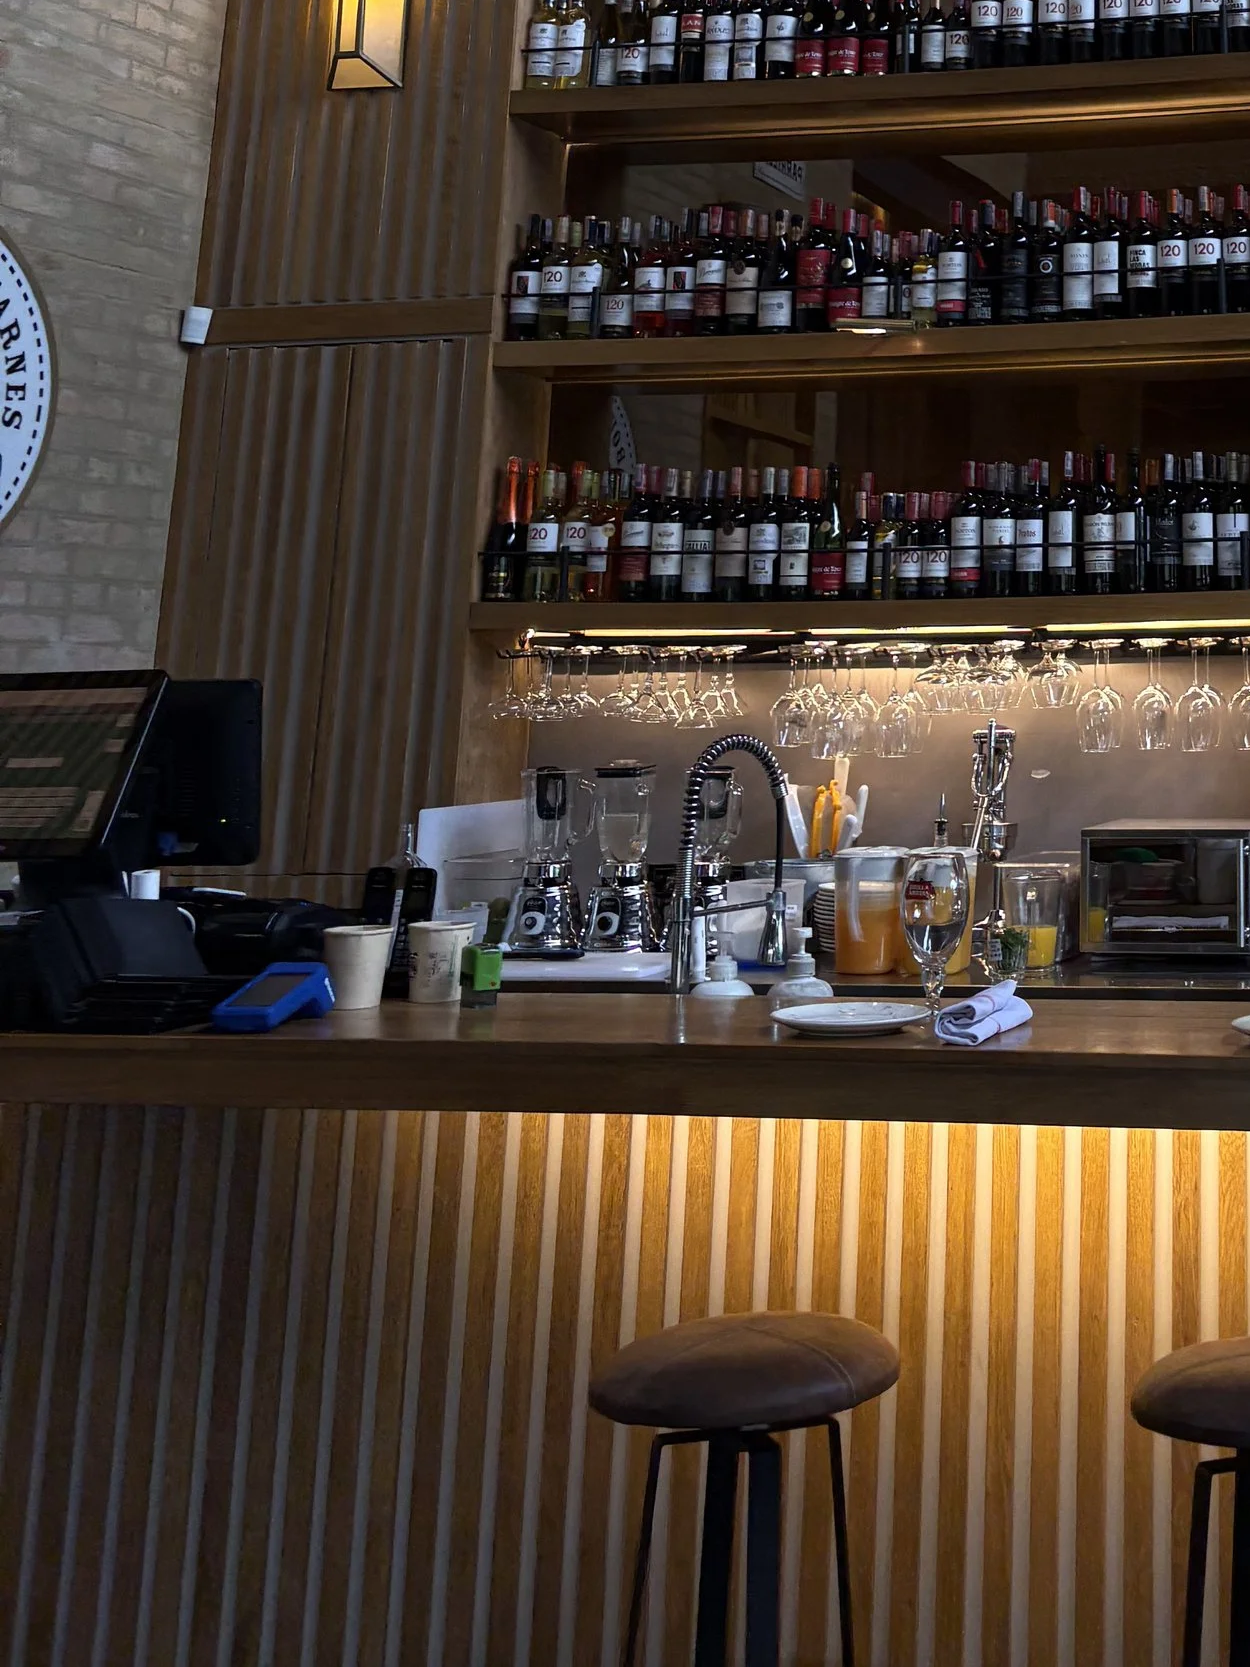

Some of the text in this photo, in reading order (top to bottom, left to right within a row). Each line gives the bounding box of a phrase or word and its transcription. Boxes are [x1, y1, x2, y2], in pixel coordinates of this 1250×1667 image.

[978, 5, 998, 17] 120
[1006, 7, 1023, 18] 120
[1046, 2, 1066, 14] 120
[950, 34, 970, 45] 120
[621, 47, 640, 59] 120
[1161, 245, 1181, 257] 120
[1194, 242, 1214, 255] 120
[1226, 241, 1247, 254] 120
[606, 299, 624, 310] 120
[0, 281, 28, 431] ARNES
[566, 527, 587, 539] 120
[899, 551, 920, 564] 120
[926, 550, 947, 564] 120
